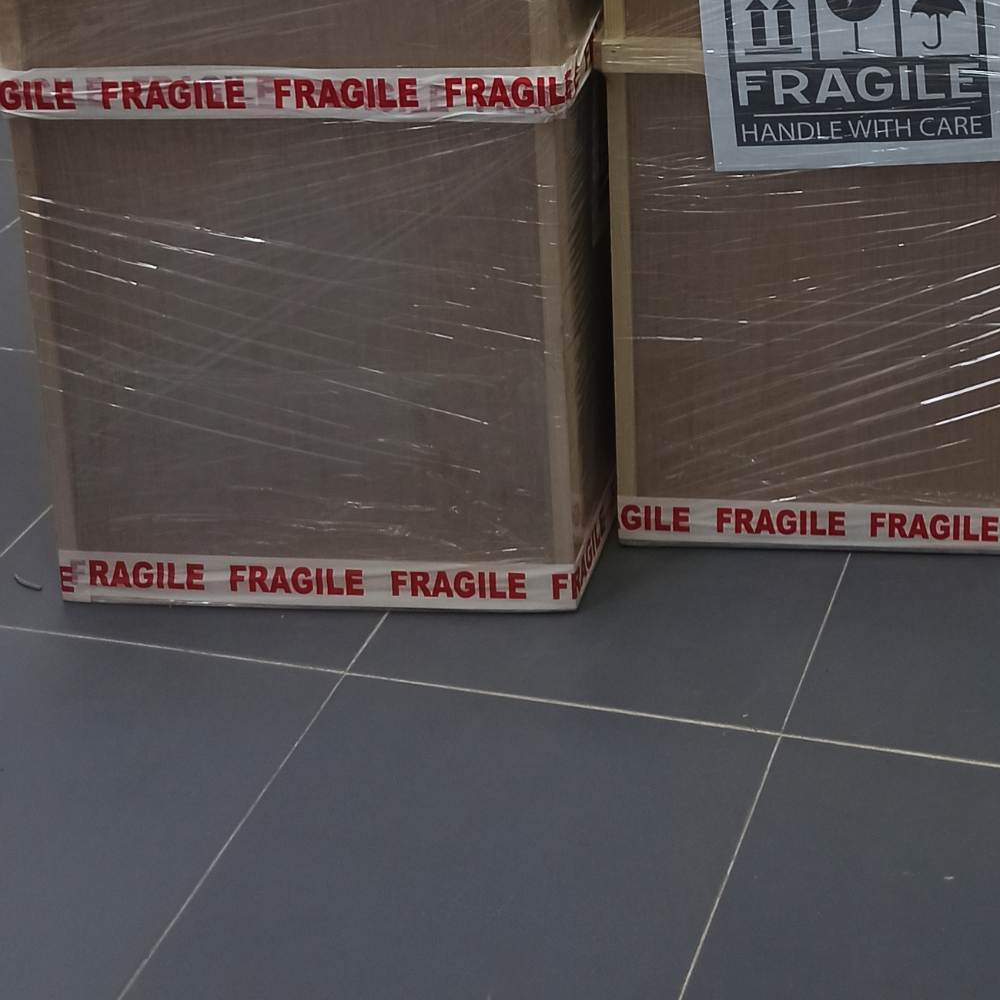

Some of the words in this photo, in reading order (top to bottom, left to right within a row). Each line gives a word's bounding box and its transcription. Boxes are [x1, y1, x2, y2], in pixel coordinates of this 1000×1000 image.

[101, 80, 246, 111] FRAGILE
[273, 78, 419, 111] FRAGILE
[736, 62, 983, 107] FRAGILE
[741, 120, 843, 143] HANDLE
[844, 118, 911, 140] WITH
[919, 115, 983, 137] CARE
[717, 508, 845, 538] FRAGILE
[870, 514, 998, 543] FRAGILE
[229, 566, 364, 597] FRAGILE
[391, 571, 527, 602] FRAGILE
